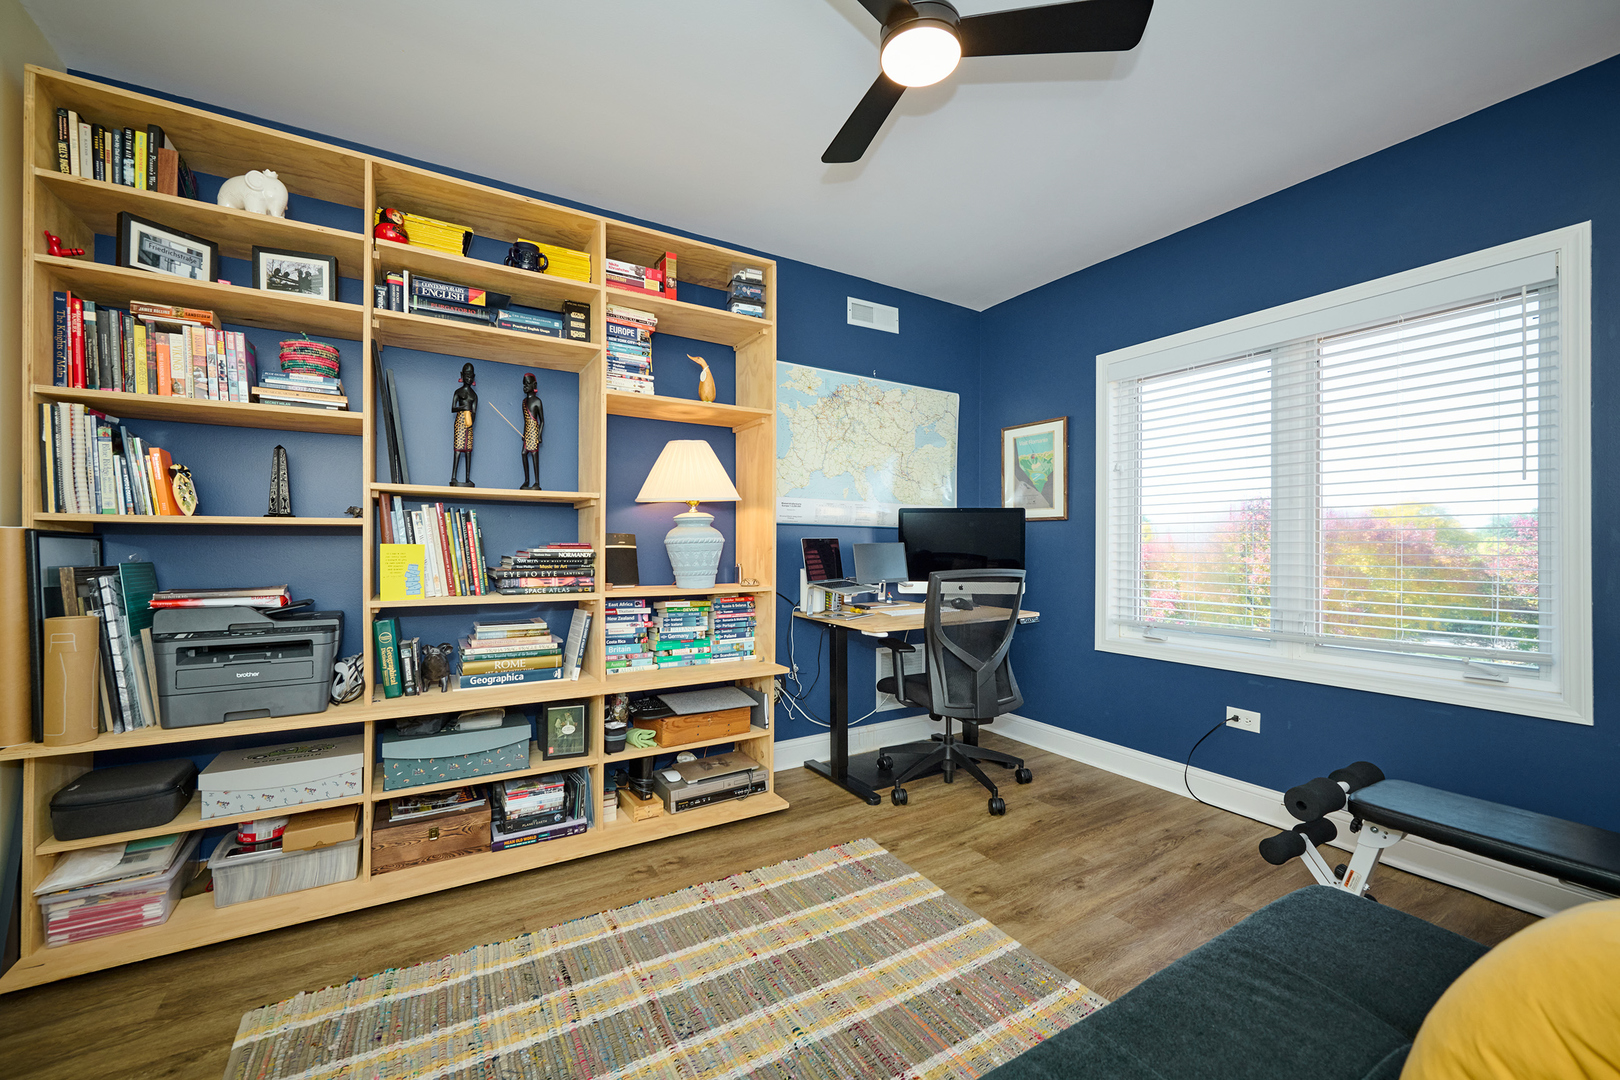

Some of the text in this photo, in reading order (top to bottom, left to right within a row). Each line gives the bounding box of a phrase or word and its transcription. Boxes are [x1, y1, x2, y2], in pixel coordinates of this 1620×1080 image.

[58, 143, 68, 158] HELL'S
[422, 281, 464, 294] CONTEMPORARY
[422, 288, 465, 302] ENGLISH
[430, 302, 477, 314] PURGATORIO
[610, 325, 635, 338] EUROPE
[54, 310, 66, 378] The Knights of Malta
[138, 337, 146, 348] THE
[194, 334, 202, 354] TSUKIJI
[172, 346, 183, 372] VIKINGS
[608, 646, 632, 654] Britain
[386, 646, 398, 686] Geographical
[494, 659, 526, 670] ROME
[470, 673, 524, 686] Geographica
[522, 820, 537, 828] PLANET
